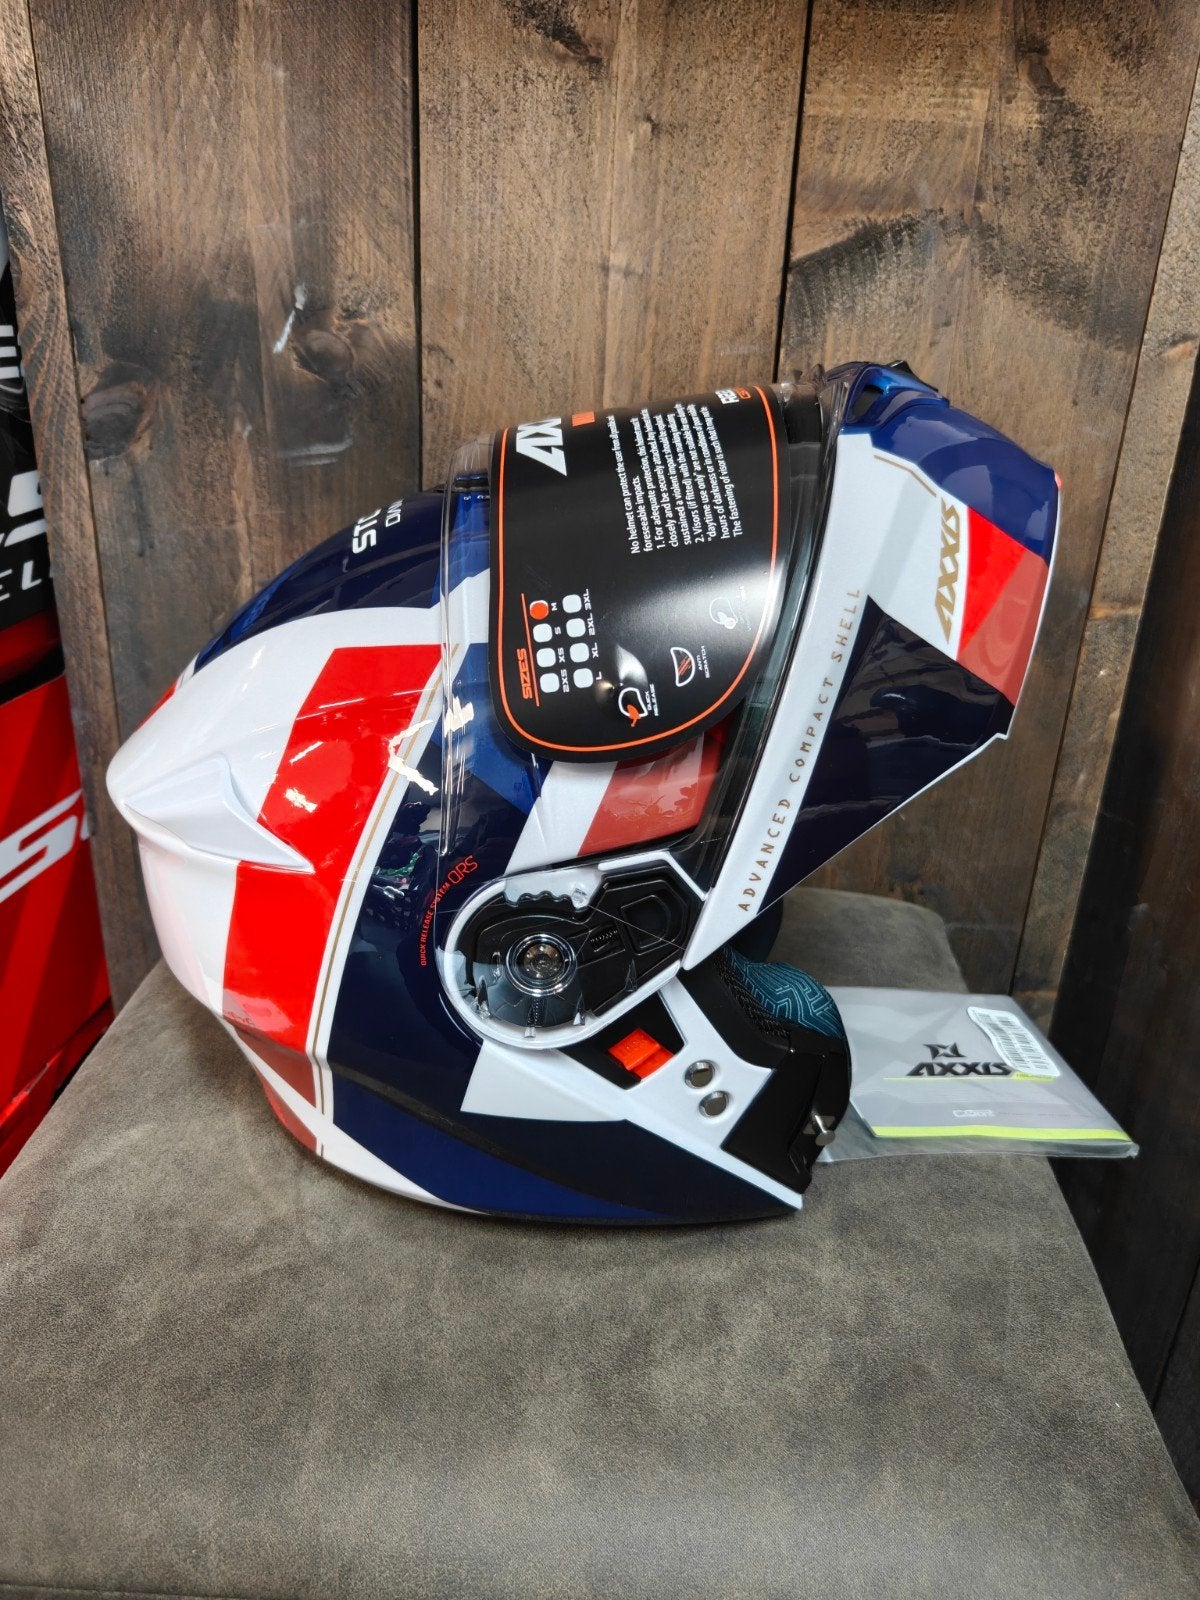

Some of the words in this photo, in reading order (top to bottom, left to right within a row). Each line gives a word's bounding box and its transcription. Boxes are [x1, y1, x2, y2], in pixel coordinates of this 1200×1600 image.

[688, 449, 699, 461] not
[696, 430, 711, 459] conditions
[710, 440, 723, 454] such
[615, 462, 625, 473] the
[664, 453, 677, 476] impact
[676, 452, 687, 464] the
[692, 460, 702, 471] are
[717, 459, 728, 476] visor
[640, 455, 656, 490] protection,
[653, 465, 668, 492] securely
[678, 462, 690, 478] with
[618, 472, 632, 497] protect
[632, 475, 645, 505] impacts.
[669, 475, 682, 500] violent
[681, 478, 695, 501] fitted)
[708, 472, 723, 505] darkness
[623, 497, 633, 511] can
[647, 489, 662, 525] adequate
[686, 500, 699, 510] (if
[699, 489, 709, 504] use
[724, 483, 739, 520] fastening
[660, 502, 673, 518] and
[625, 511, 638, 540] helmet
[636, 504, 653, 552] foreseeable
[654, 526, 664, 541] For
[665, 519, 679, 548] closely
[674, 505, 692, 545] sustained
[690, 509, 703, 535] Visors
[718, 514, 731, 539] hours
[732, 520, 743, 537] The
[935, 497, 961, 645] AXXIS
[551, 602, 558, 611] M
[583, 588, 592, 610] 3XL
[554, 626, 561, 635] S
[587, 613, 596, 636] 2XL
[558, 647, 566, 663] XS
[591, 642, 599, 658] XL
[516, 648, 533, 699] SIZES
[701, 645, 710, 679] SCRATCH
[560, 669, 570, 693] 2XS
[596, 671, 603, 681] L
[650, 683, 659, 716] RELEASE
[737, 798, 791, 912] ADVANCED
[789, 677, 834, 783] COMPACT
[831, 588, 861, 663] SHELL
[420, 911, 434, 943] RELEASE
[429, 882, 451, 911] SYSTEM
[447, 855, 478, 884] QRS
[905, 1062, 1012, 1077] AXXIS
